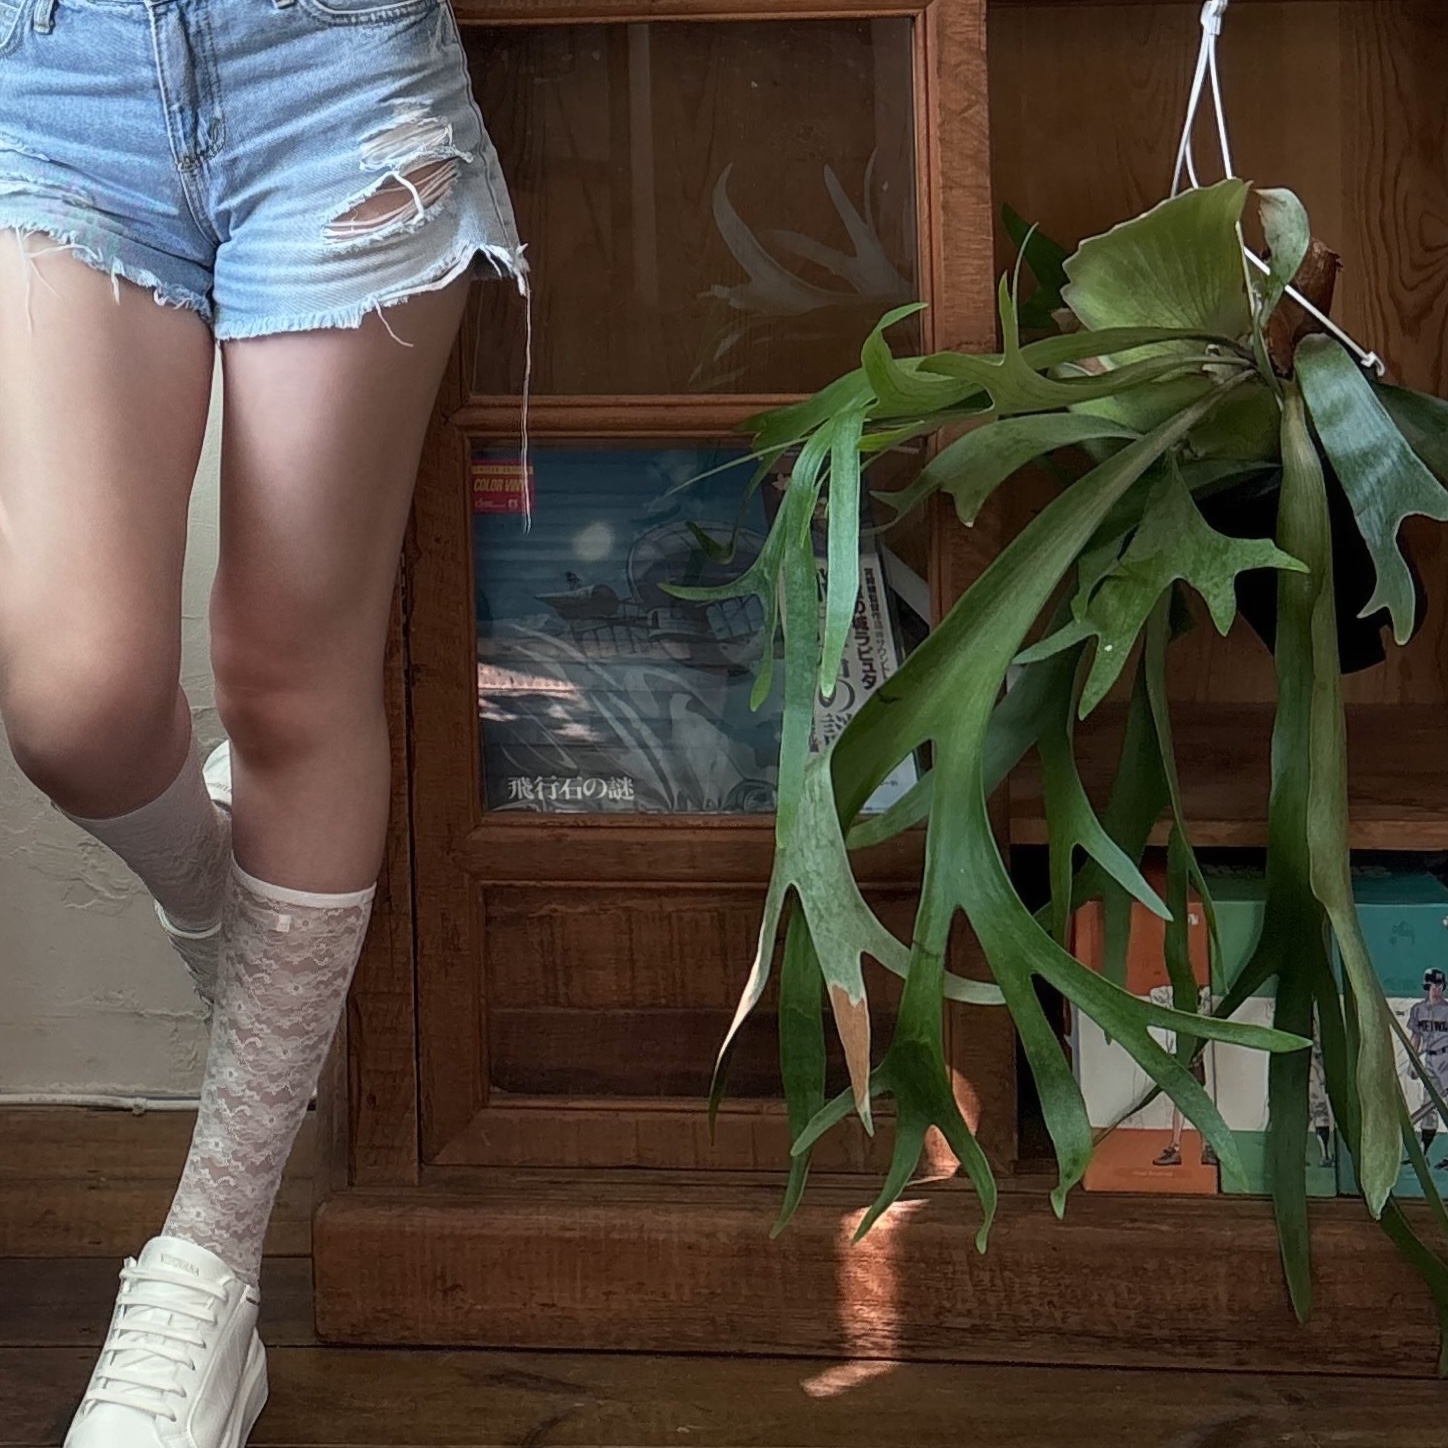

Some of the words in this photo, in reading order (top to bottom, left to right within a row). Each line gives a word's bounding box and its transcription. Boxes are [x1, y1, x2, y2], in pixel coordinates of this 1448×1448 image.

[474, 478, 503, 492] COLOR
[508, 775, 636, 801] 飛行石の謎
